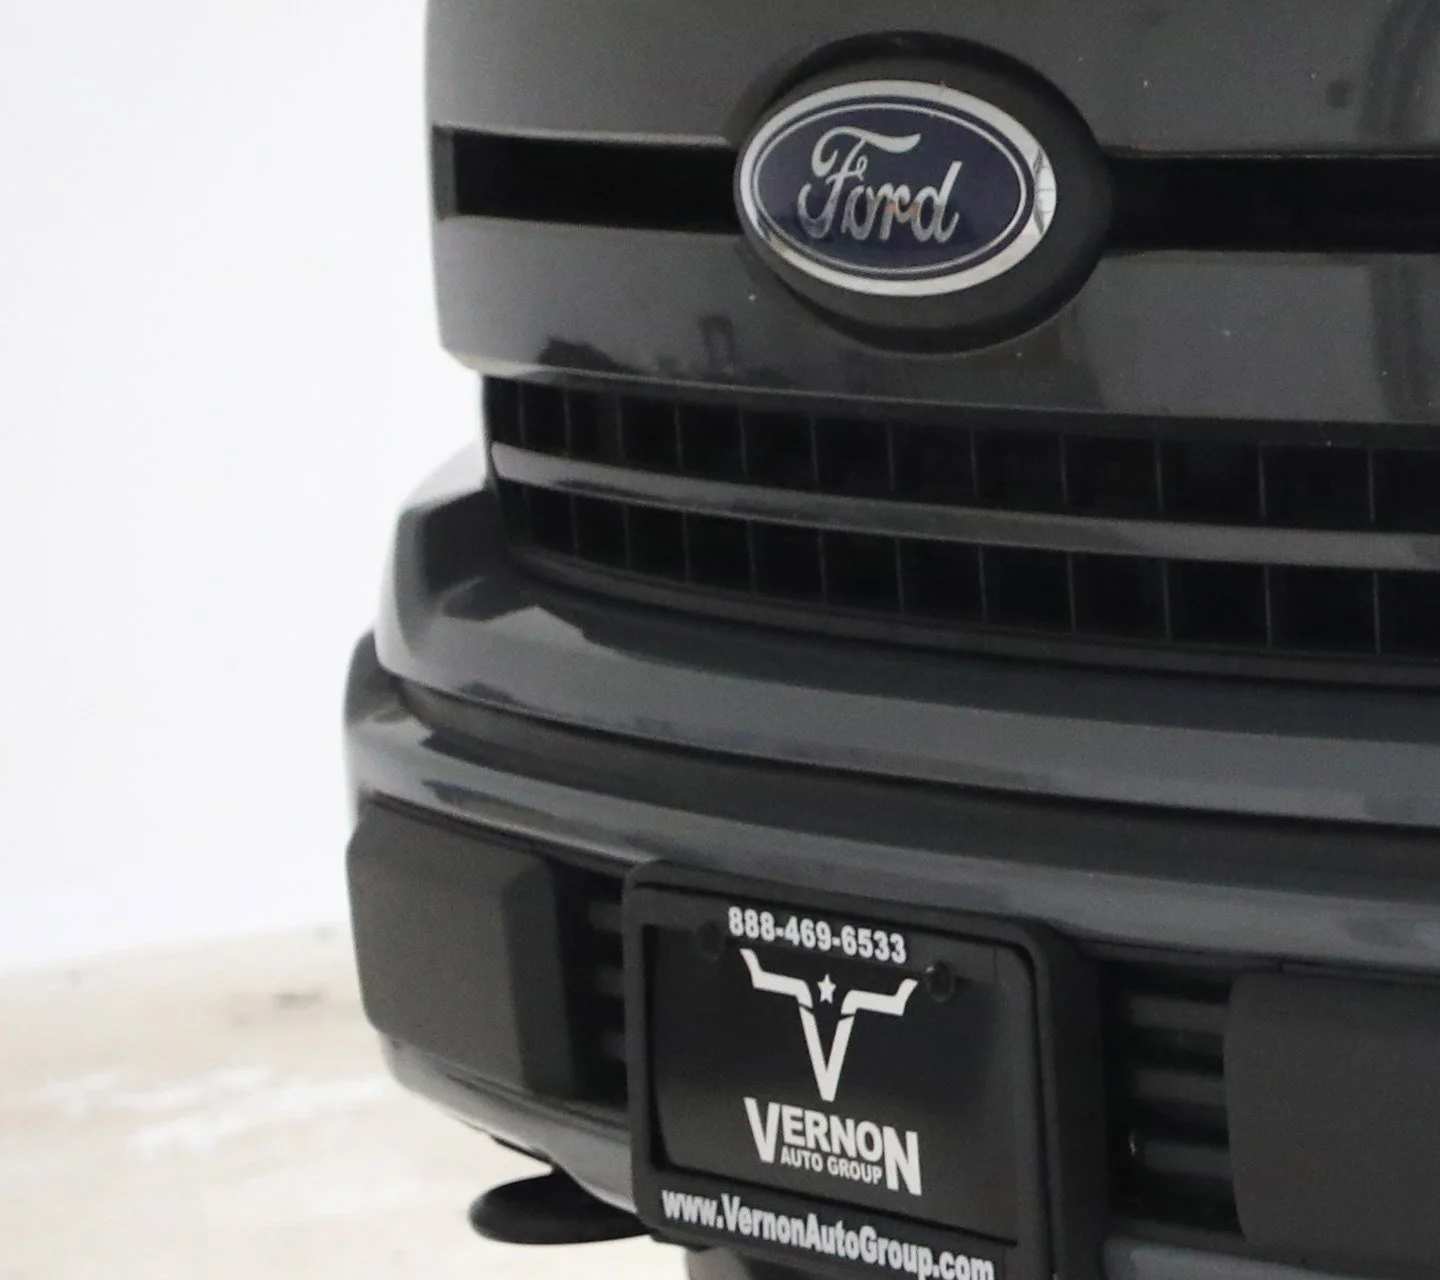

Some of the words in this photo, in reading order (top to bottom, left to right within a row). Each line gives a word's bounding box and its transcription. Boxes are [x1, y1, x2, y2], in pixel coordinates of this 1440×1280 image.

[797, 125, 964, 244] Ford
[728, 906, 907, 964] 888-469-6533
[743, 1096, 922, 1196] VERNON
[780, 1146, 823, 1173] AUTO
[826, 1156, 883, 1186] GROUP
